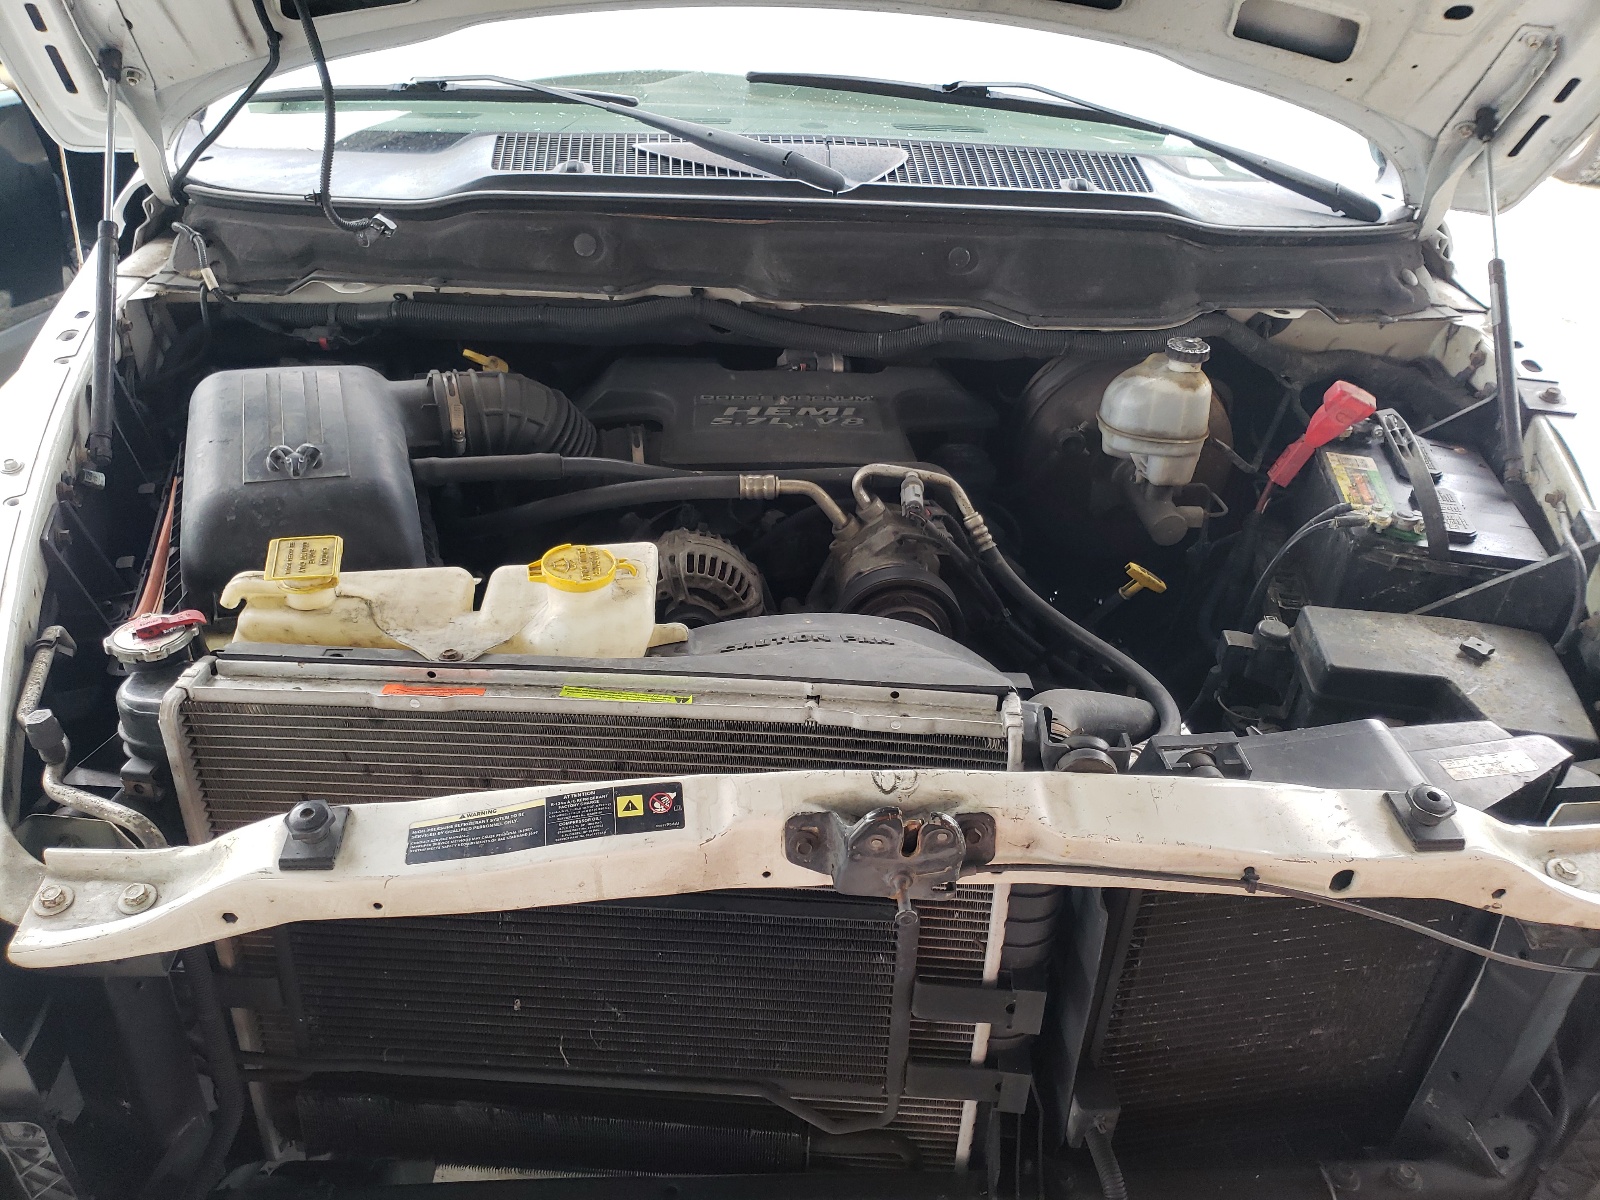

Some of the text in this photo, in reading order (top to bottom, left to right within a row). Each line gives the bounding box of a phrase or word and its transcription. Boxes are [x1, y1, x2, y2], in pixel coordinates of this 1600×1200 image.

[723, 406, 856, 416] HEMI
[710, 417, 865, 427] 5.7L V8
[720, 634, 895, 653] CAUTION FAN
[563, 790, 596, 800] ATTENTION
[466, 808, 497, 818] WARNING
